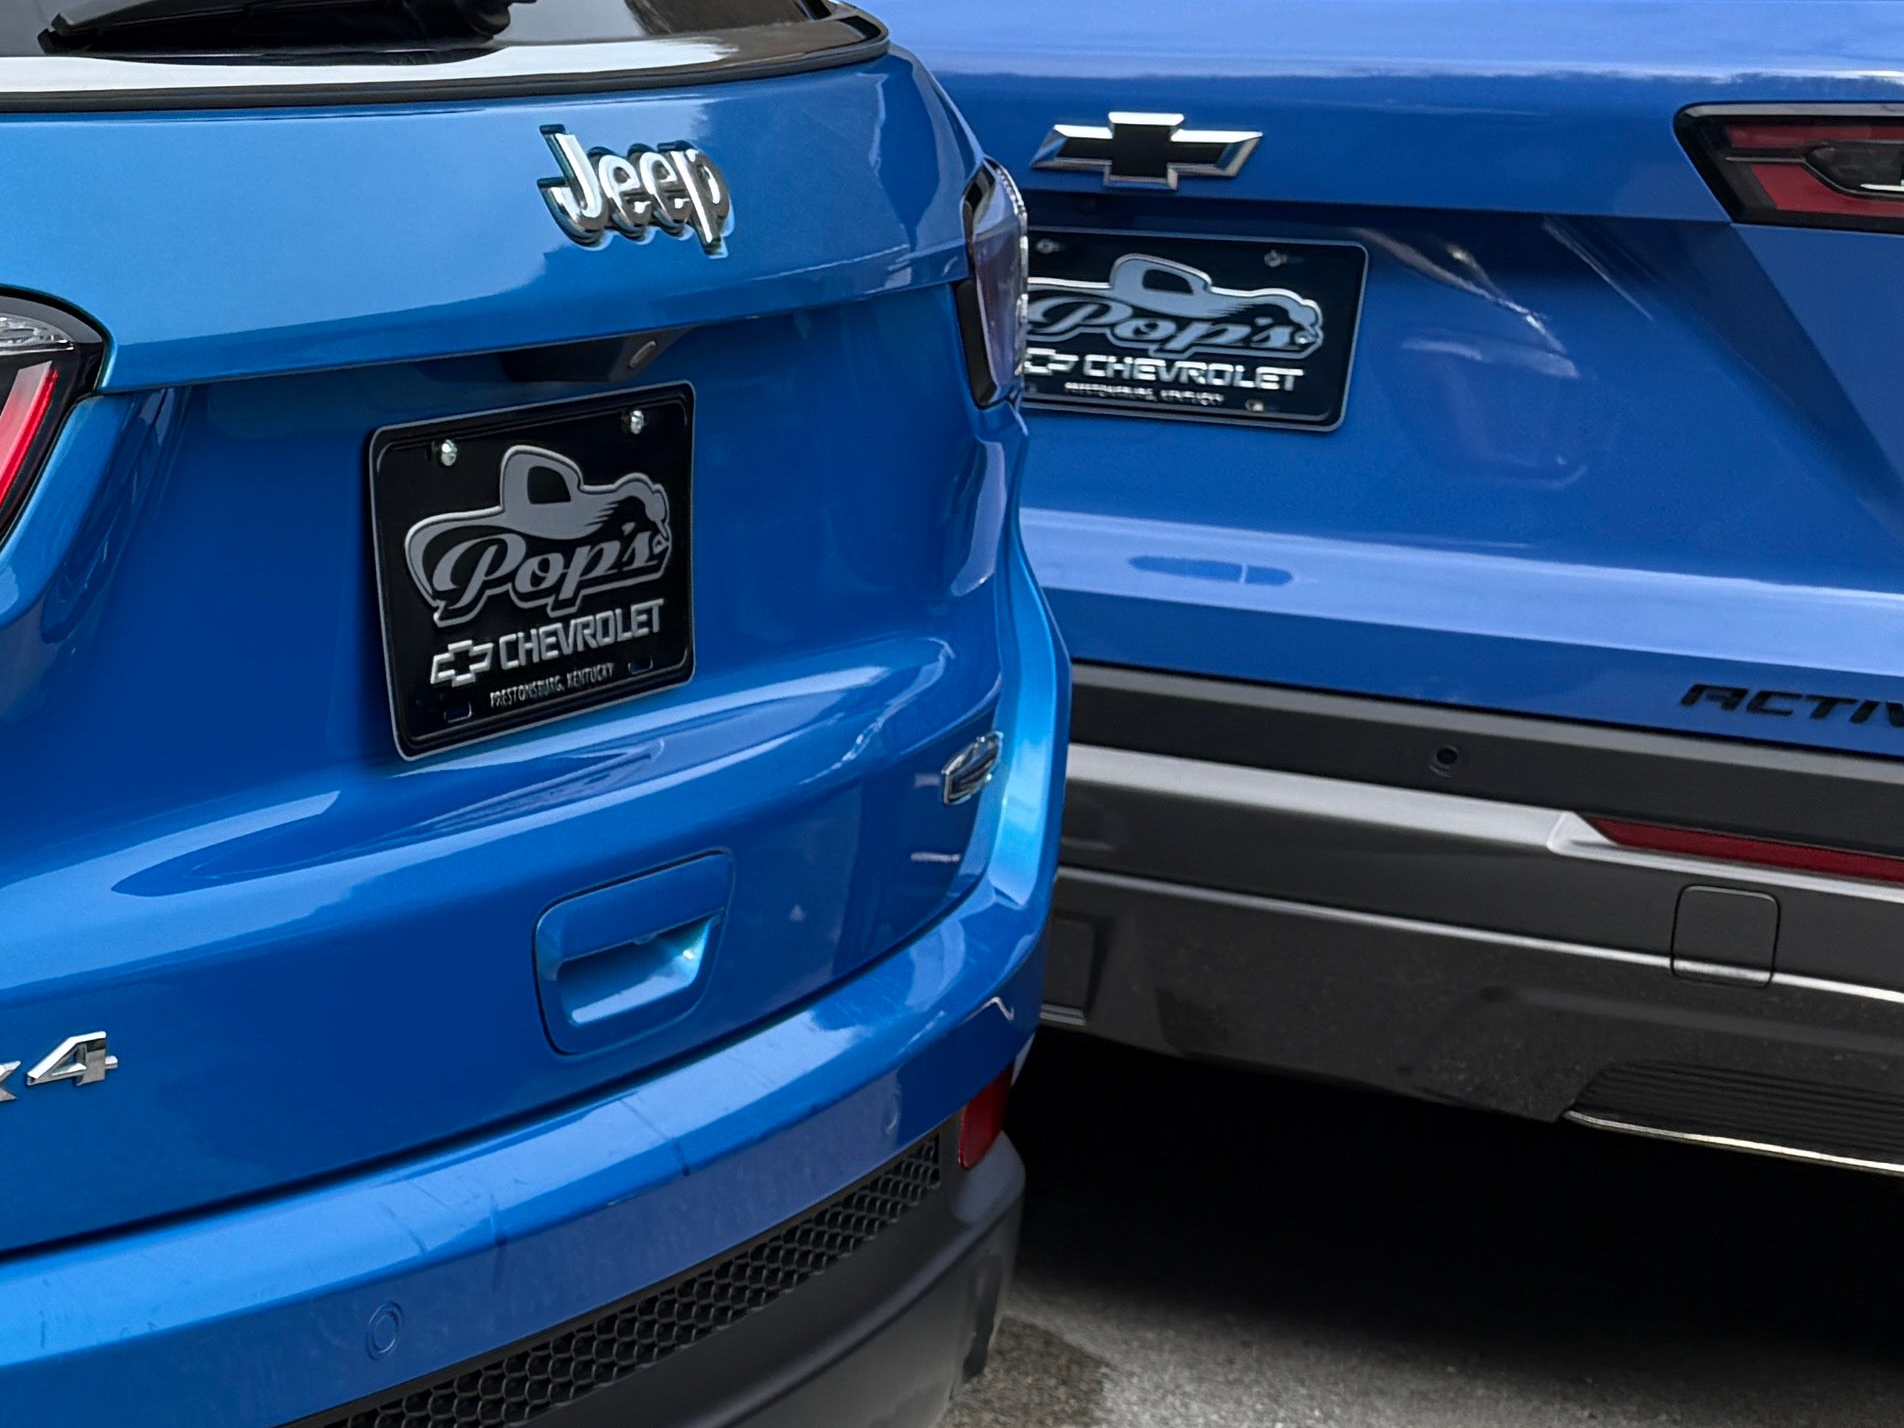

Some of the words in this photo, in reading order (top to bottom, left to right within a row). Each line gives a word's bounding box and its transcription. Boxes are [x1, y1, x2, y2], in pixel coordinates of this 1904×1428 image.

[536, 123, 733, 259] Jeep
[1027, 296, 1305, 355] Pop's
[1083, 354, 1305, 392] CHEVROLET
[430, 522, 663, 610] Pop's
[497, 598, 665, 670] CHEVROLET
[566, 662, 615, 688] KENTUCKY
